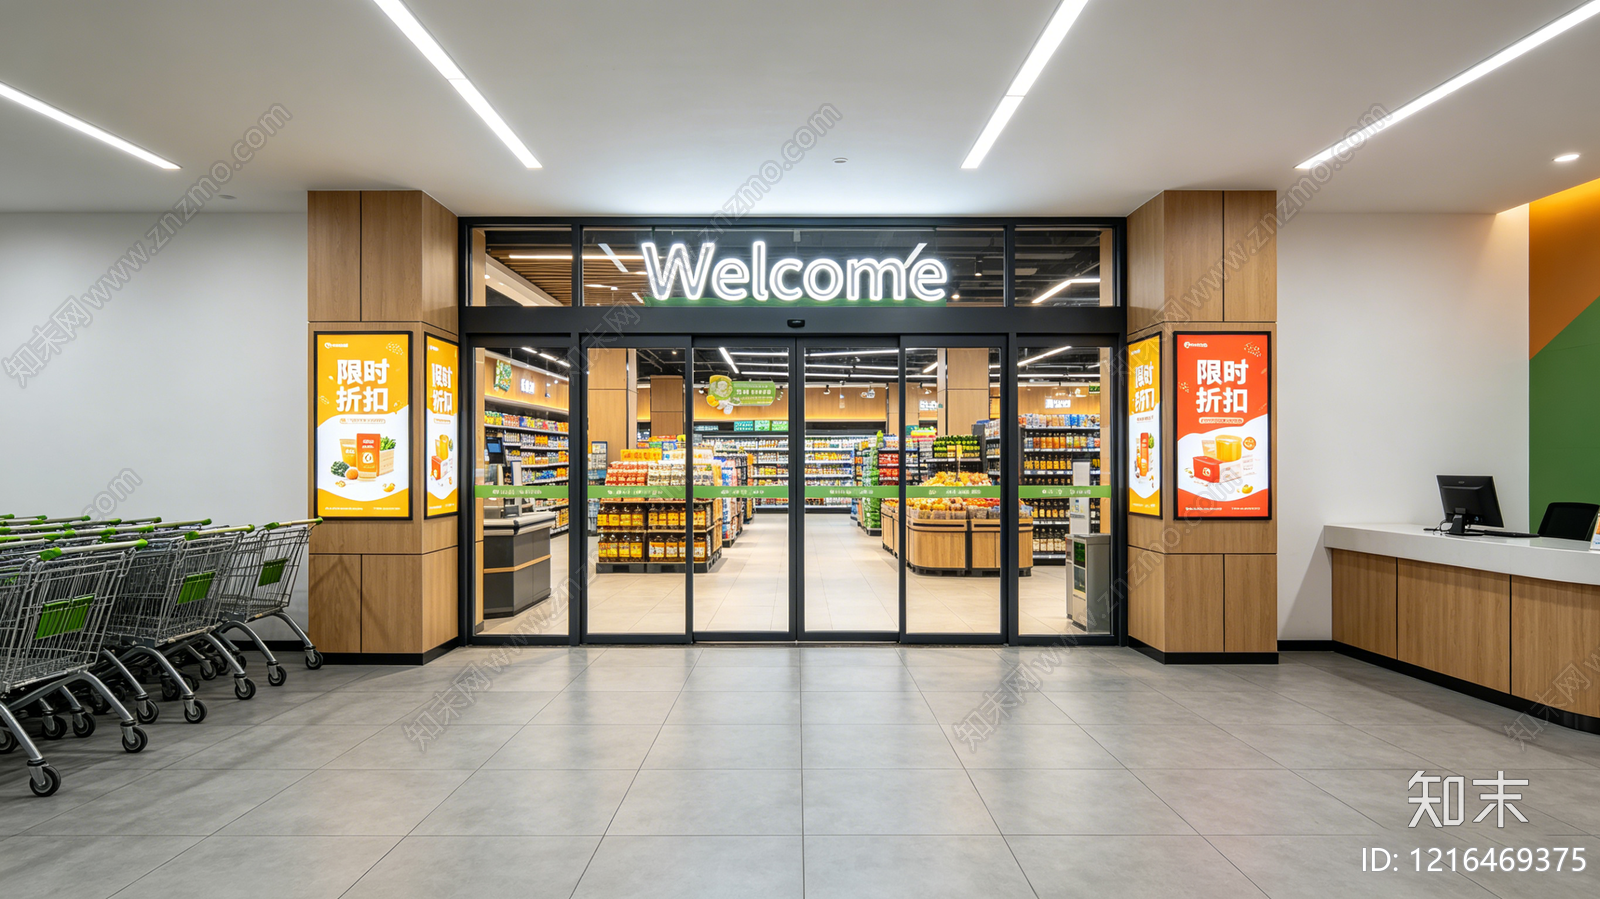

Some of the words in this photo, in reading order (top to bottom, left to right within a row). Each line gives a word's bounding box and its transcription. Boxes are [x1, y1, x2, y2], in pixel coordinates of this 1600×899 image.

[641, 240, 948, 301] Welcome
[337, 358, 390, 385] 限时
[1197, 358, 1249, 385] 限时
[336, 386, 388, 412] 折扣
[1196, 386, 1248, 413] 折扣
